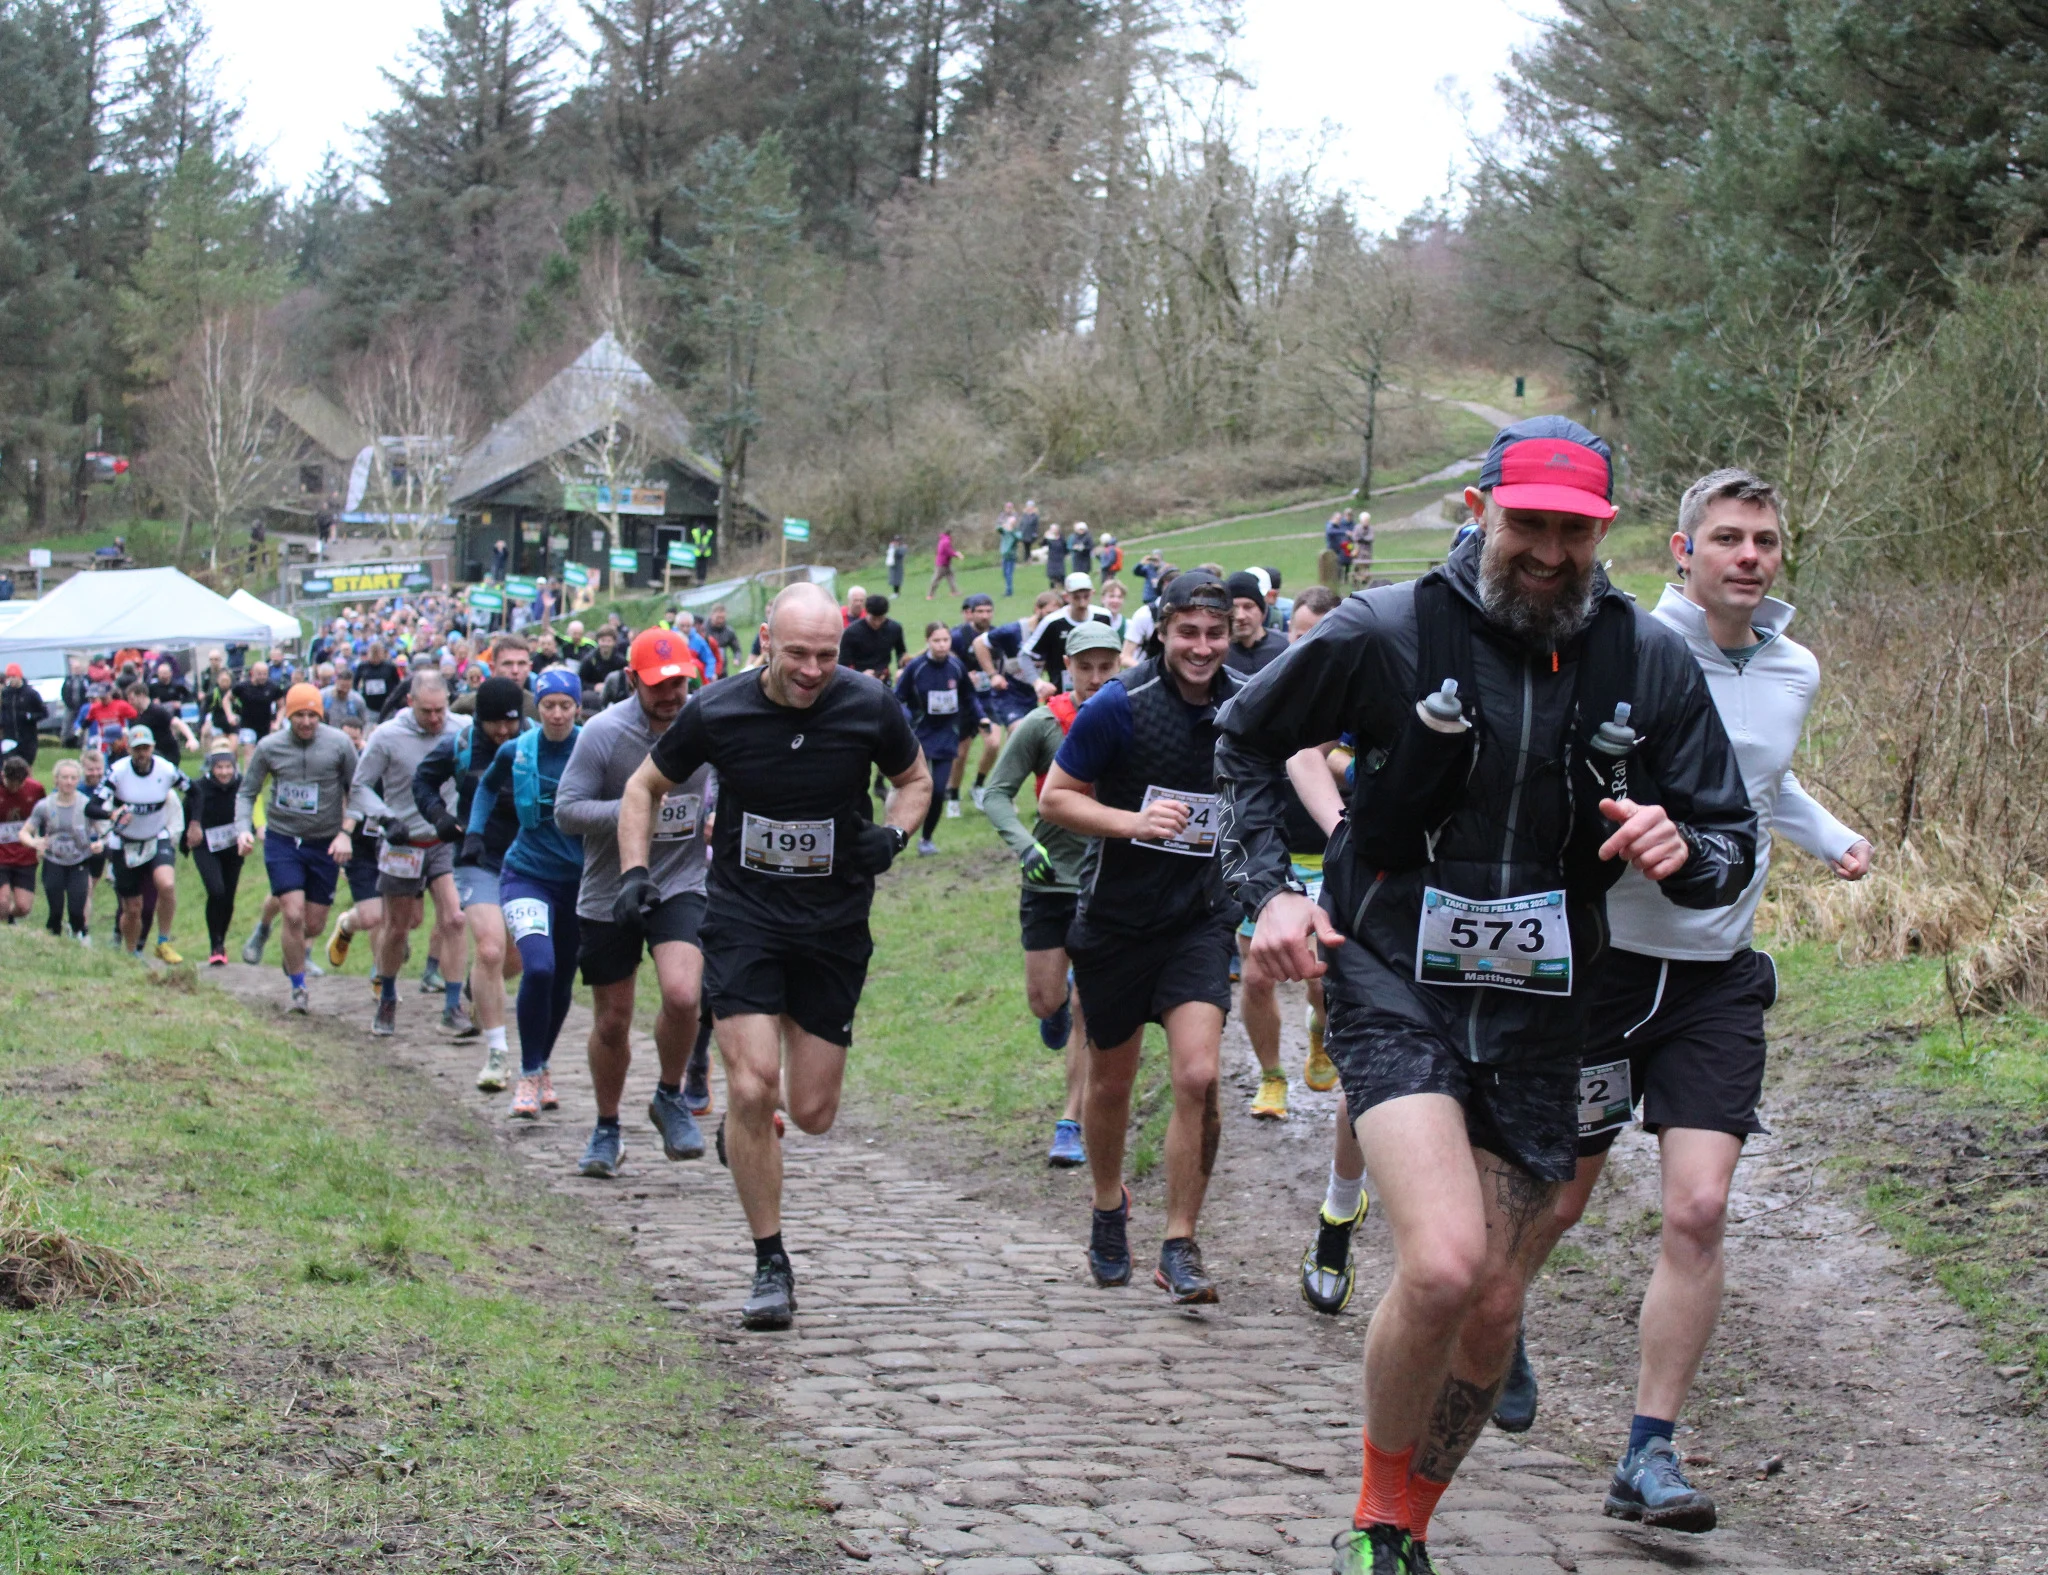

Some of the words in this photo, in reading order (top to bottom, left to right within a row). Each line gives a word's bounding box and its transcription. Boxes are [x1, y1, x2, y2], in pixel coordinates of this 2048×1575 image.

[332, 574, 402, 592] START
[1611, 760, 1628, 794] Rab
[761, 831, 817, 852] 199
[1445, 898, 1468, 910] TAKE
[1470, 905, 1489, 913] THE
[1490, 904, 1513, 913] FELL
[1449, 917, 1545, 953] 573
[1464, 972, 1526, 986] Matthew
